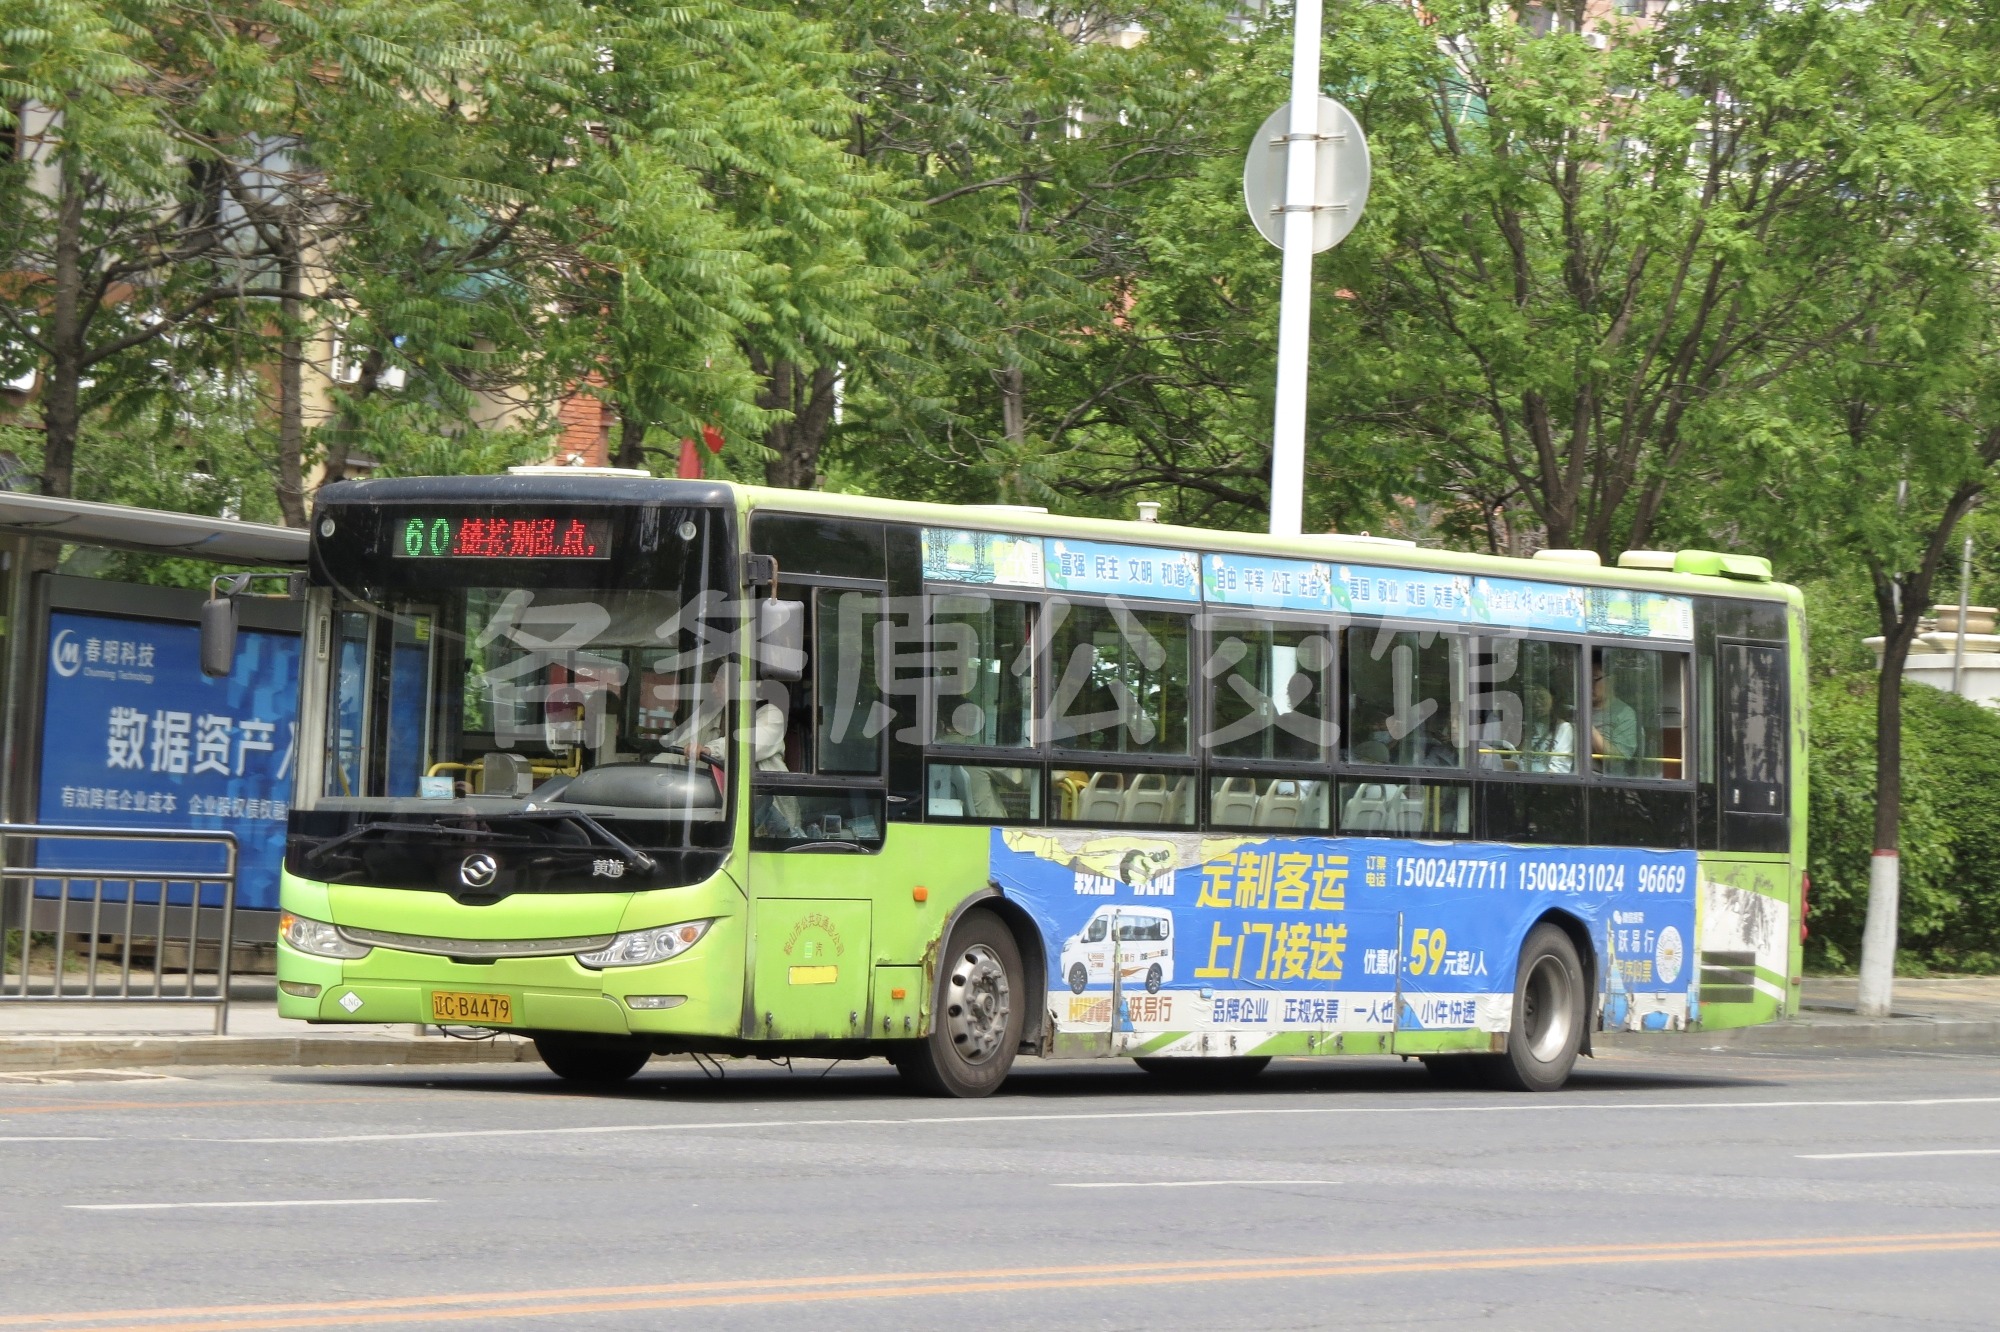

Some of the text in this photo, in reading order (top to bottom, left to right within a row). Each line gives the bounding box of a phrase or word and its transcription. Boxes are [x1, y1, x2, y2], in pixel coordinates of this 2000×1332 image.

[405, 518, 450, 556] 60
[1060, 552, 1086, 579] 富强
[1095, 556, 1119, 581] 民主
[1128, 558, 1153, 584] 文明
[1161, 562, 1186, 588] 和谐
[1216, 566, 1319, 598] 自由 平等 公正 法治
[1349, 577, 1454, 609] 爱国 敬业 诚信 友善
[84, 637, 155, 668] 春明科技
[60, 785, 178, 814] 有效降低企业成本
[593, 859, 625, 878] 黄海
[1365, 856, 1387, 871] 订票
[1396, 857, 1686, 893] 15002477711 15002431024 96669
[1195, 851, 1350, 911] 定制客运
[1365, 873, 1387, 887] 电话
[1194, 921, 1348, 980] 上门接送
[1607, 929, 1655, 953] 跃易行
[343, 997, 360, 1008] LNG
[1212, 998, 1268, 1024] 品牌企业
[1283, 998, 1340, 1024] 正规发票
[1421, 999, 1477, 1024] 小件快递
